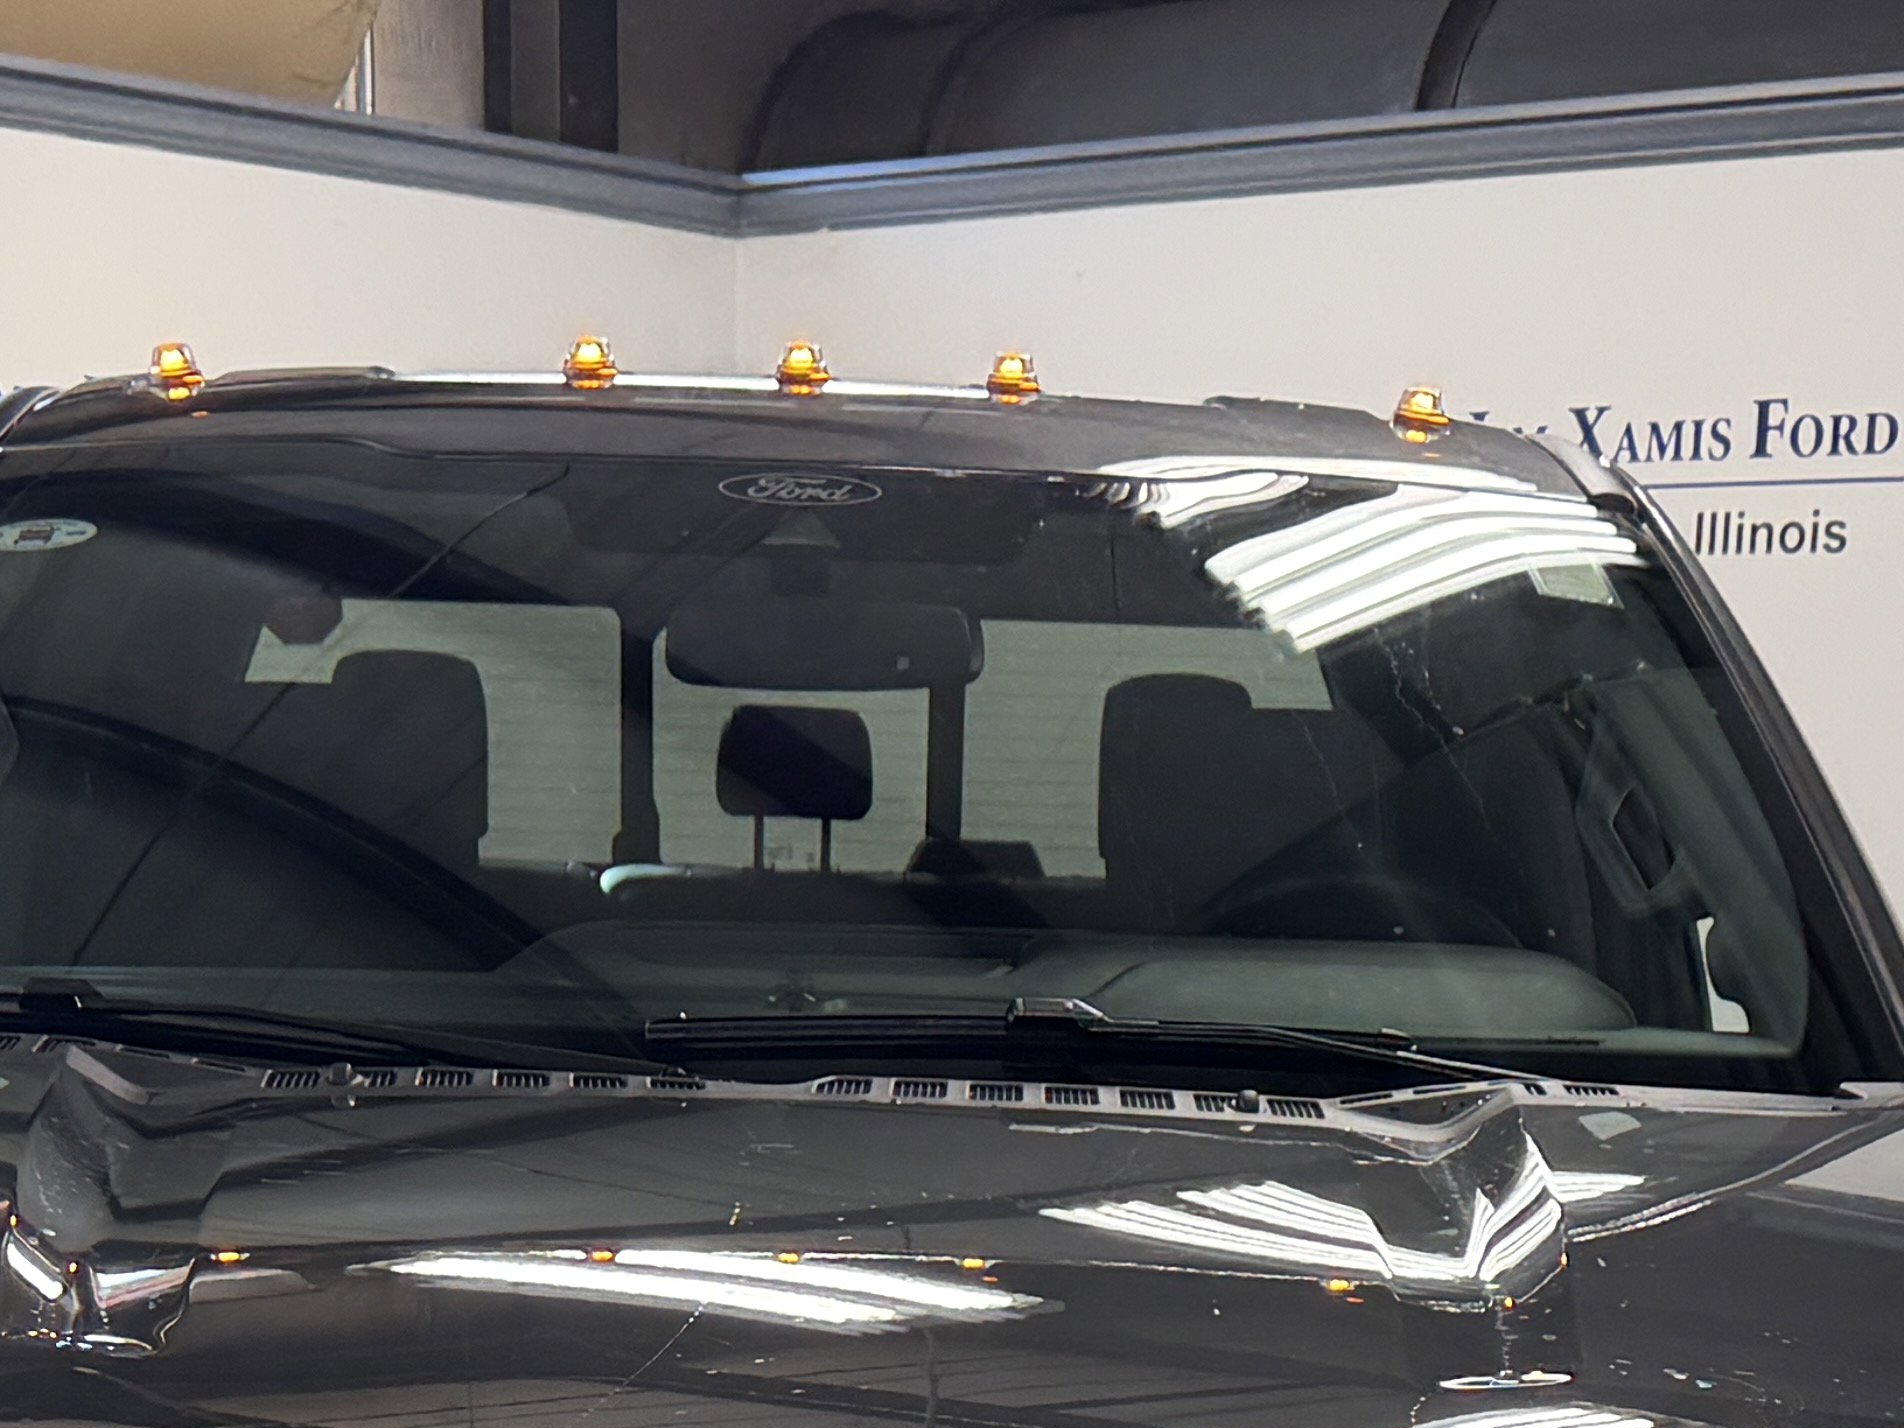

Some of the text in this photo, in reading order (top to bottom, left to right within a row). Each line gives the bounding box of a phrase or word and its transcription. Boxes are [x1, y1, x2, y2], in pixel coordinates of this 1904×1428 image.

[1568, 397, 1900, 464] XAMIS FORD
[746, 476, 853, 501] Ford
[1695, 509, 1848, 556] Illinois
